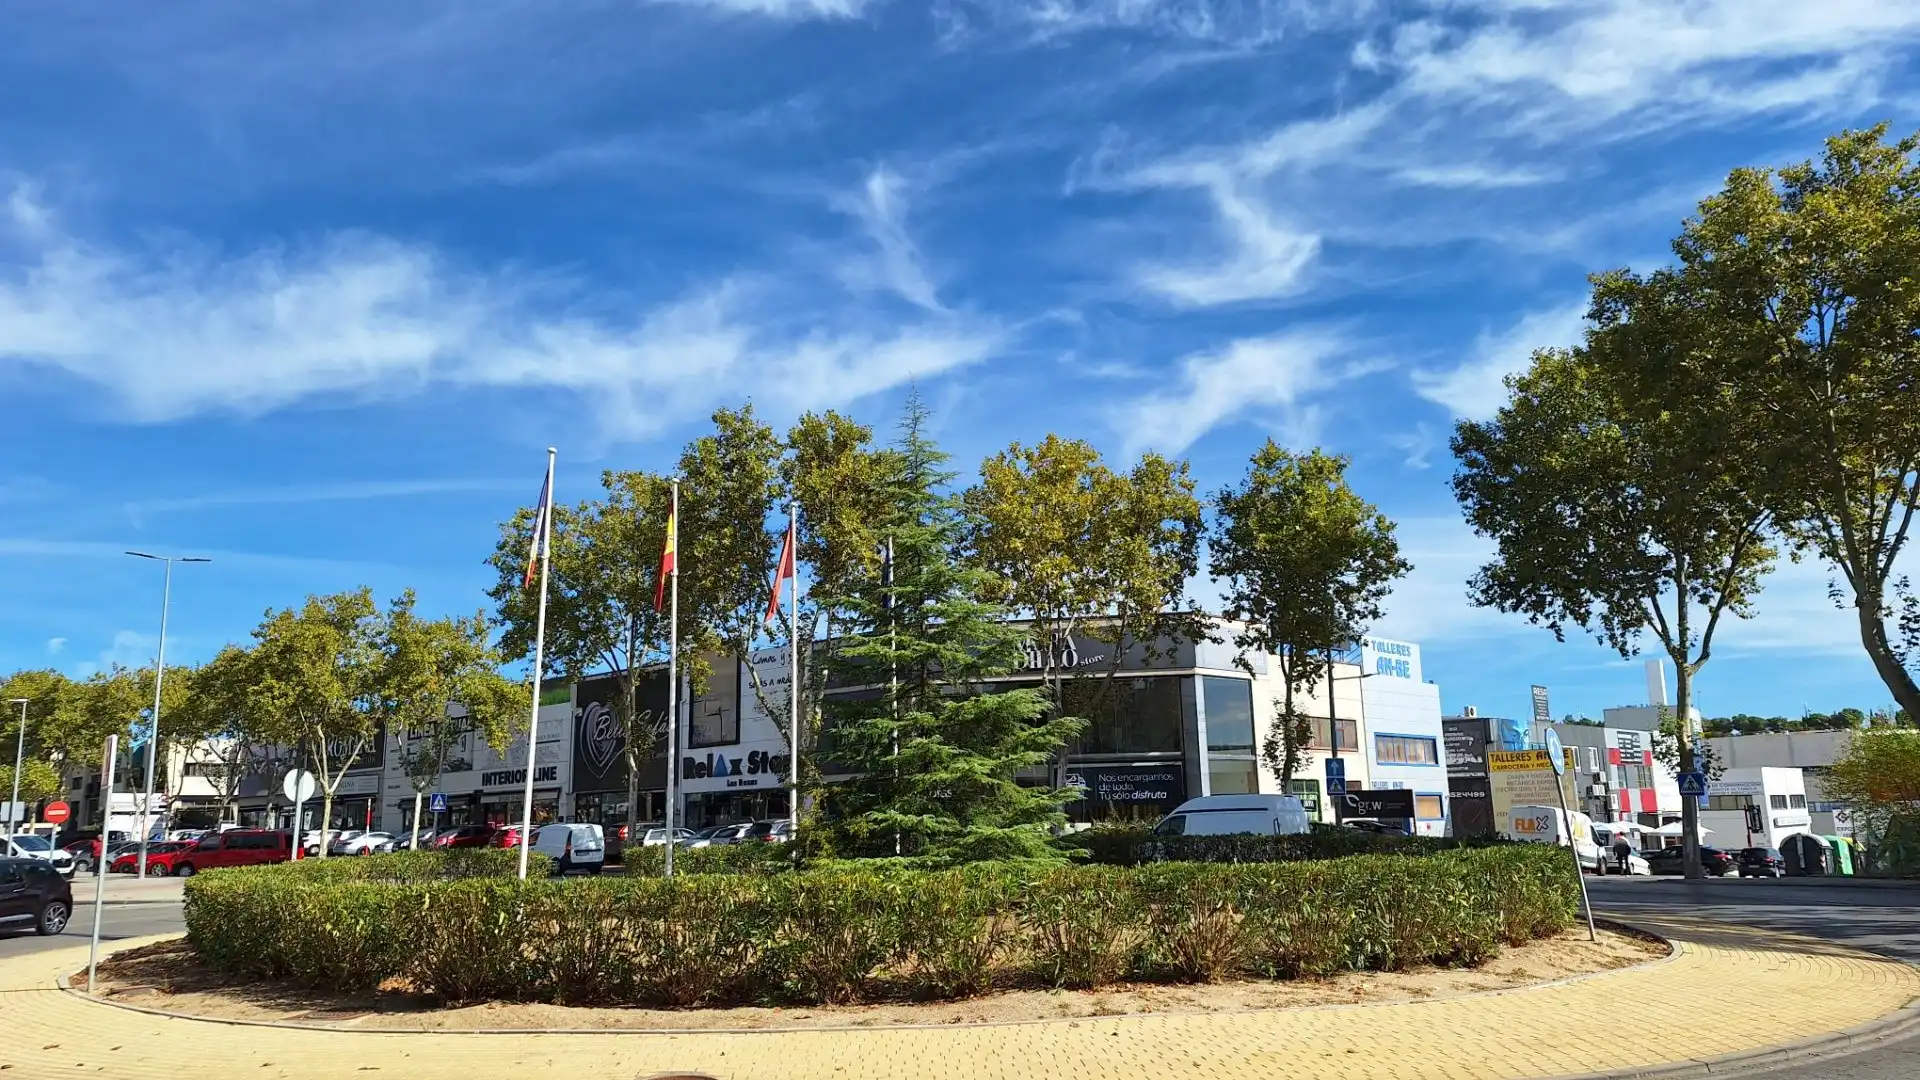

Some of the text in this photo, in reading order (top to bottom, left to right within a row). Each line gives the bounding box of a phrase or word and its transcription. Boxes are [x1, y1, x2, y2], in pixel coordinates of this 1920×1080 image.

[1371, 640, 1411, 657] TALLERES
[1080, 654, 1105, 667] store
[1376, 656, 1411, 679] AN-BE
[1490, 752, 1531, 763] TALLERES
[533, 766, 558, 782] LINE
[1099, 773, 1174, 783] Nos encargamos
[1099, 783, 1110, 791] de
[1099, 790, 1167, 800] Tú sólo disfruta
